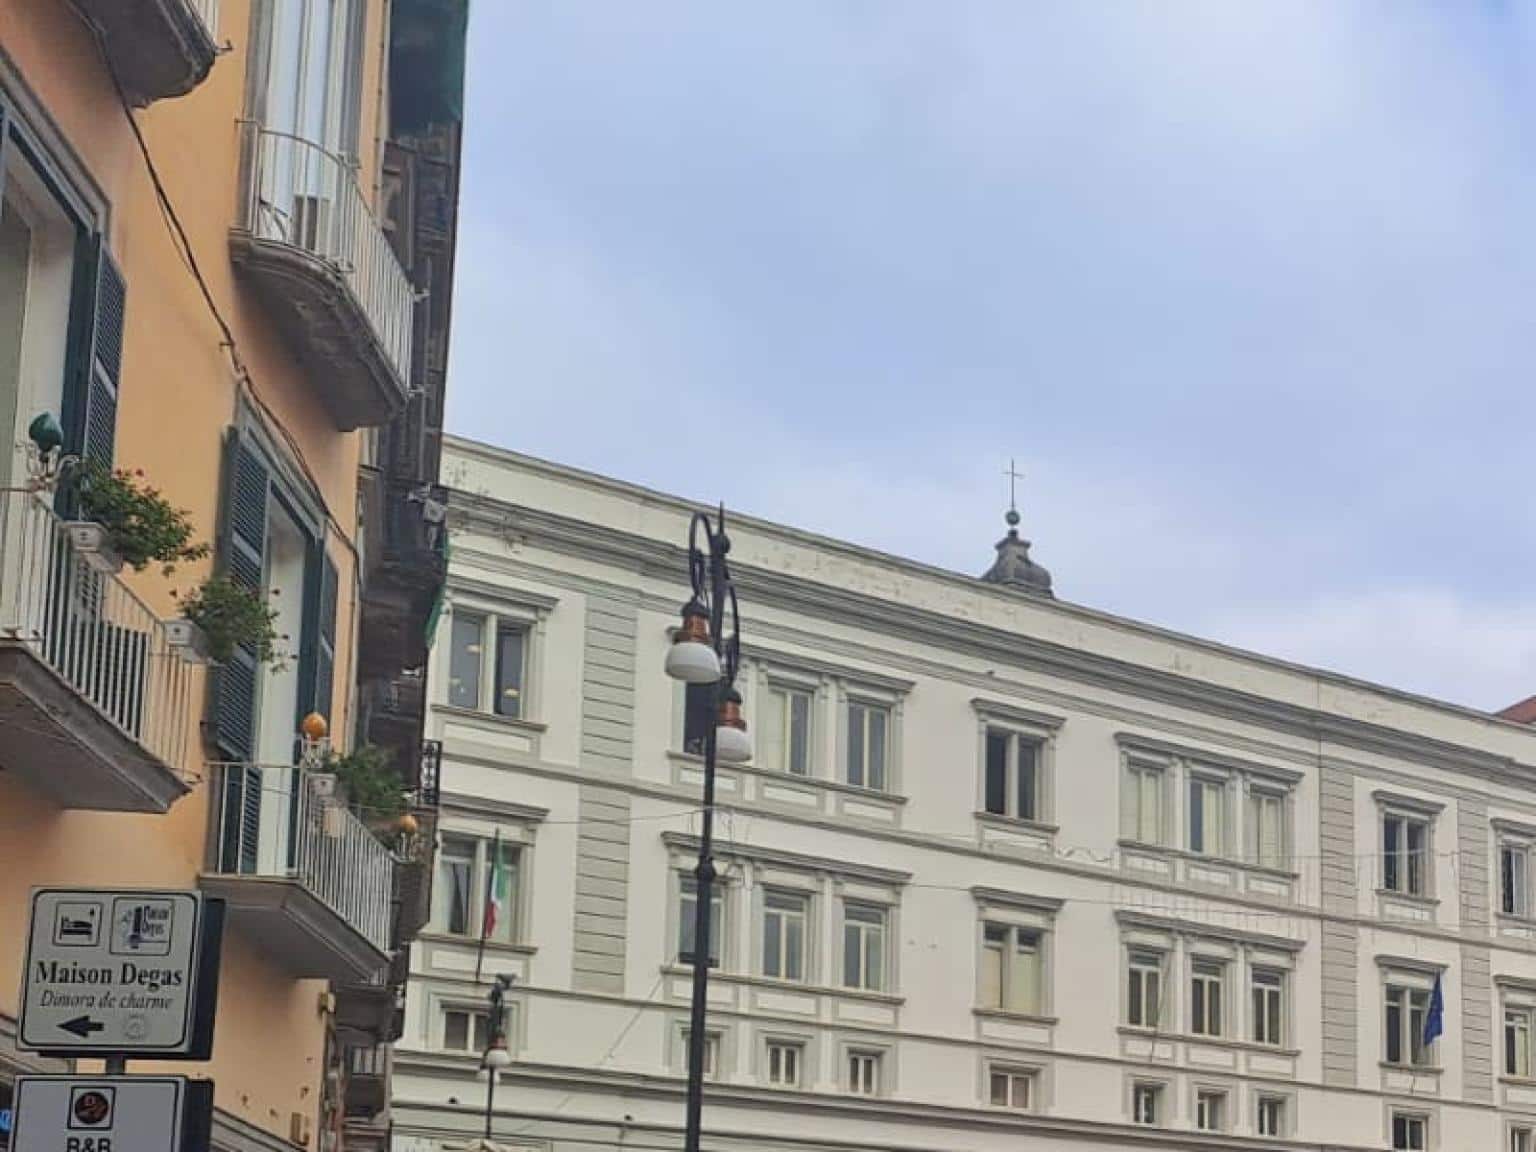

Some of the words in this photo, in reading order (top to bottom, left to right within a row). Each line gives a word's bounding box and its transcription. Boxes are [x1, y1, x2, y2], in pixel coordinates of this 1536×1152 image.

[35, 961, 112, 985] Maison
[120, 963, 182, 991] Degas
[40, 989, 95, 1008] Dimora
[99, 991, 116, 1008] de
[118, 992, 173, 1009] charme
